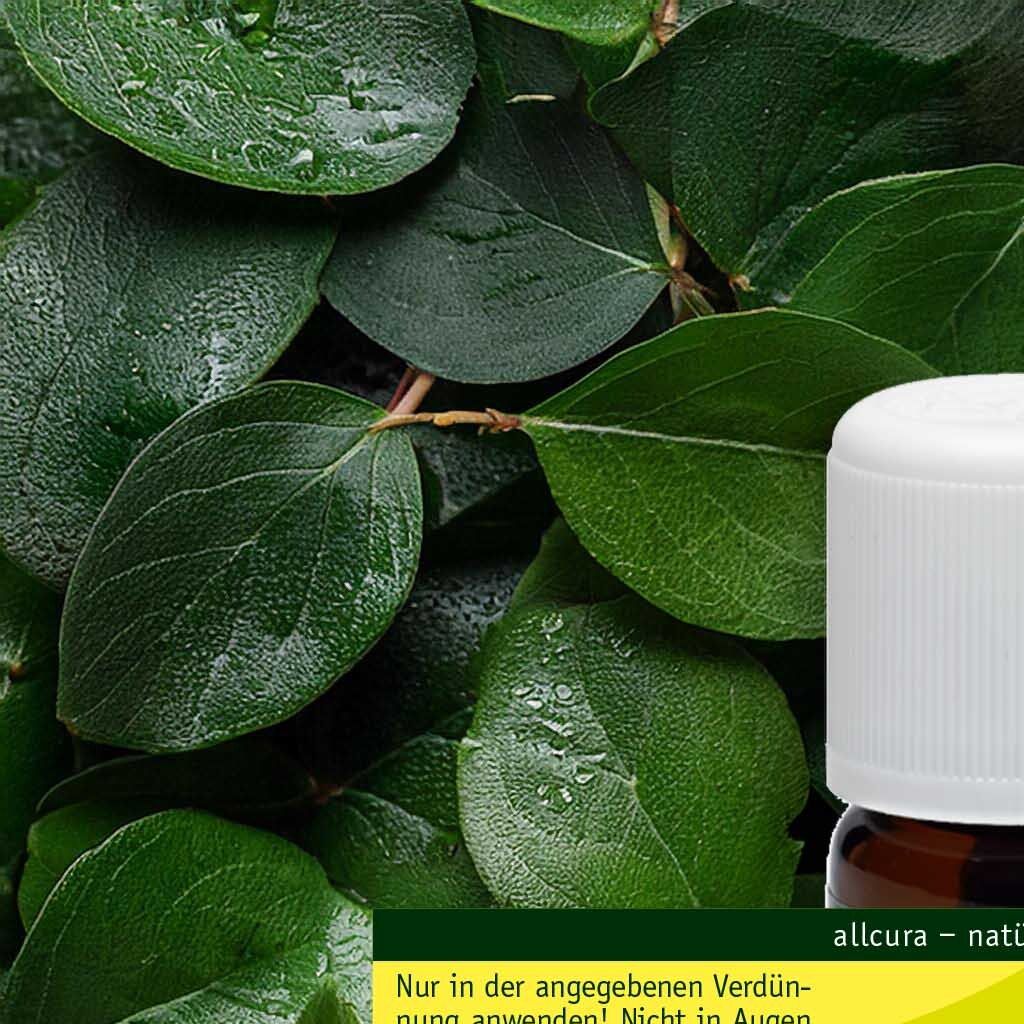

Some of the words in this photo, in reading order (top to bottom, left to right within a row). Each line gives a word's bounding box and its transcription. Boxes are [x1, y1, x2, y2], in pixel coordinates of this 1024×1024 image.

[834, 922, 926, 946] allcura
[398, 974, 439, 997] Nur
[450, 973, 473, 997] in
[485, 973, 524, 997] der
[536, 973, 702, 1004] angegebenen
[714, 973, 810, 997] Verdün-
